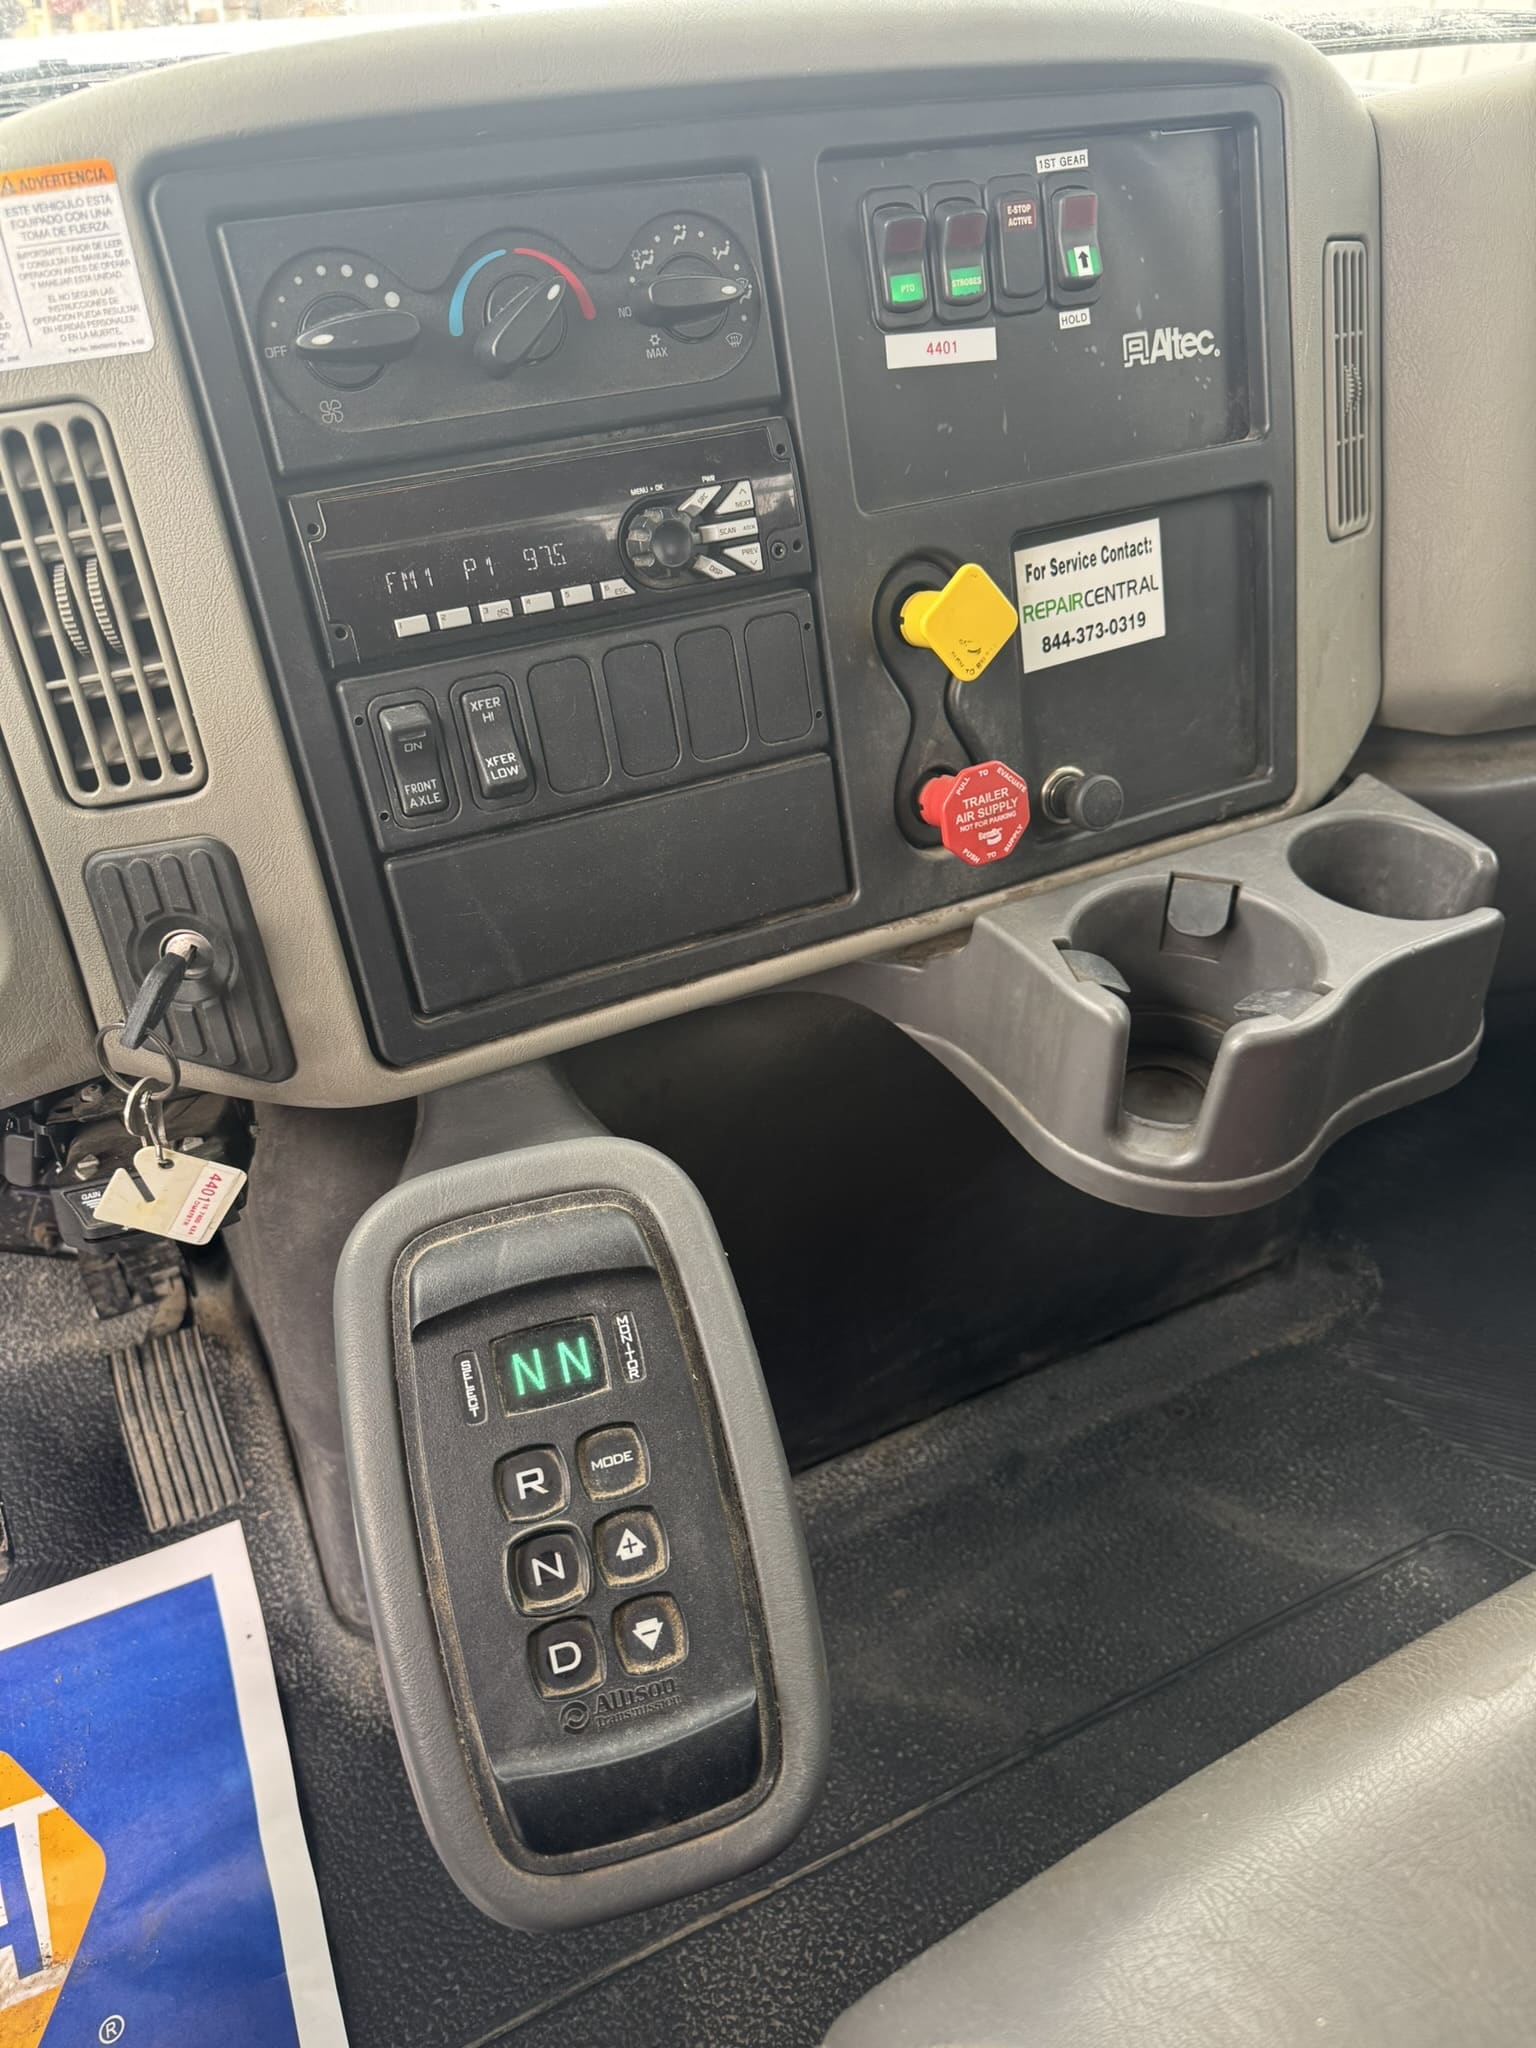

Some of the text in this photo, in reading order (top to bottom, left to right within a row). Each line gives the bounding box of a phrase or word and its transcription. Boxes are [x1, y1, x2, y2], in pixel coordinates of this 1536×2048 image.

[1038, 154, 1087, 170] 1ST GEAR
[20, 167, 107, 193] ADVERTENCIA
[5, 205, 31, 218] ESTE
[32, 198, 84, 214] VEHICULO
[1007, 204, 1032, 216] E-STOP
[10, 207, 113, 231] EQUIPADO CON UNA
[1007, 215, 1033, 227] ACTIVE
[22, 220, 110, 241] TOMA DE FUERZA
[900, 283, 916, 294] PTO
[951, 275, 982, 289] STROBES
[1061, 314, 1087, 327] HOLD
[264, 345, 288, 359] OFF
[646, 346, 669, 360] MAX
[926, 341, 958, 356] 4401
[630, 486, 649, 496] MENU
[735, 499, 752, 509] NEXT
[719, 526, 737, 536] SCAN
[741, 548, 759, 557] PREV
[1025, 536, 1153, 584] For Service Contact:
[384, 567, 434, 595] FM1
[462, 556, 495, 581] P1
[614, 586, 628, 595] ESC
[1041, 611, 1146, 654] 844-373-0319
[469, 696, 501, 713] XFER
[482, 711, 495, 724] HI
[403, 741, 424, 753] ON
[484, 752, 517, 768] XFER
[490, 764, 521, 781] LOW
[955, 766, 1028, 796] PULL TO EVACUATE
[404, 778, 437, 795] FRONT
[409, 791, 442, 809] AXLE
[962, 786, 1010, 810] TRAILER
[955, 796, 1019, 825] AIR SUPPLY
[959, 810, 1017, 833] NOT FOR PARKING
[962, 823, 1024, 864] PUSH TO SUPPLY
[81, 1190, 102, 1201] GAIN
[198, 1173, 223, 1203] 4401
[616, 1315, 640, 1380] MONITOR
[460, 1359, 479, 1418] SELECT
[590, 1450, 634, 1471] MODE
[515, 1467, 549, 1500] R
[531, 1551, 566, 1586] N
[548, 1641, 582, 1674] D
[592, 1677, 677, 1714] Allison
